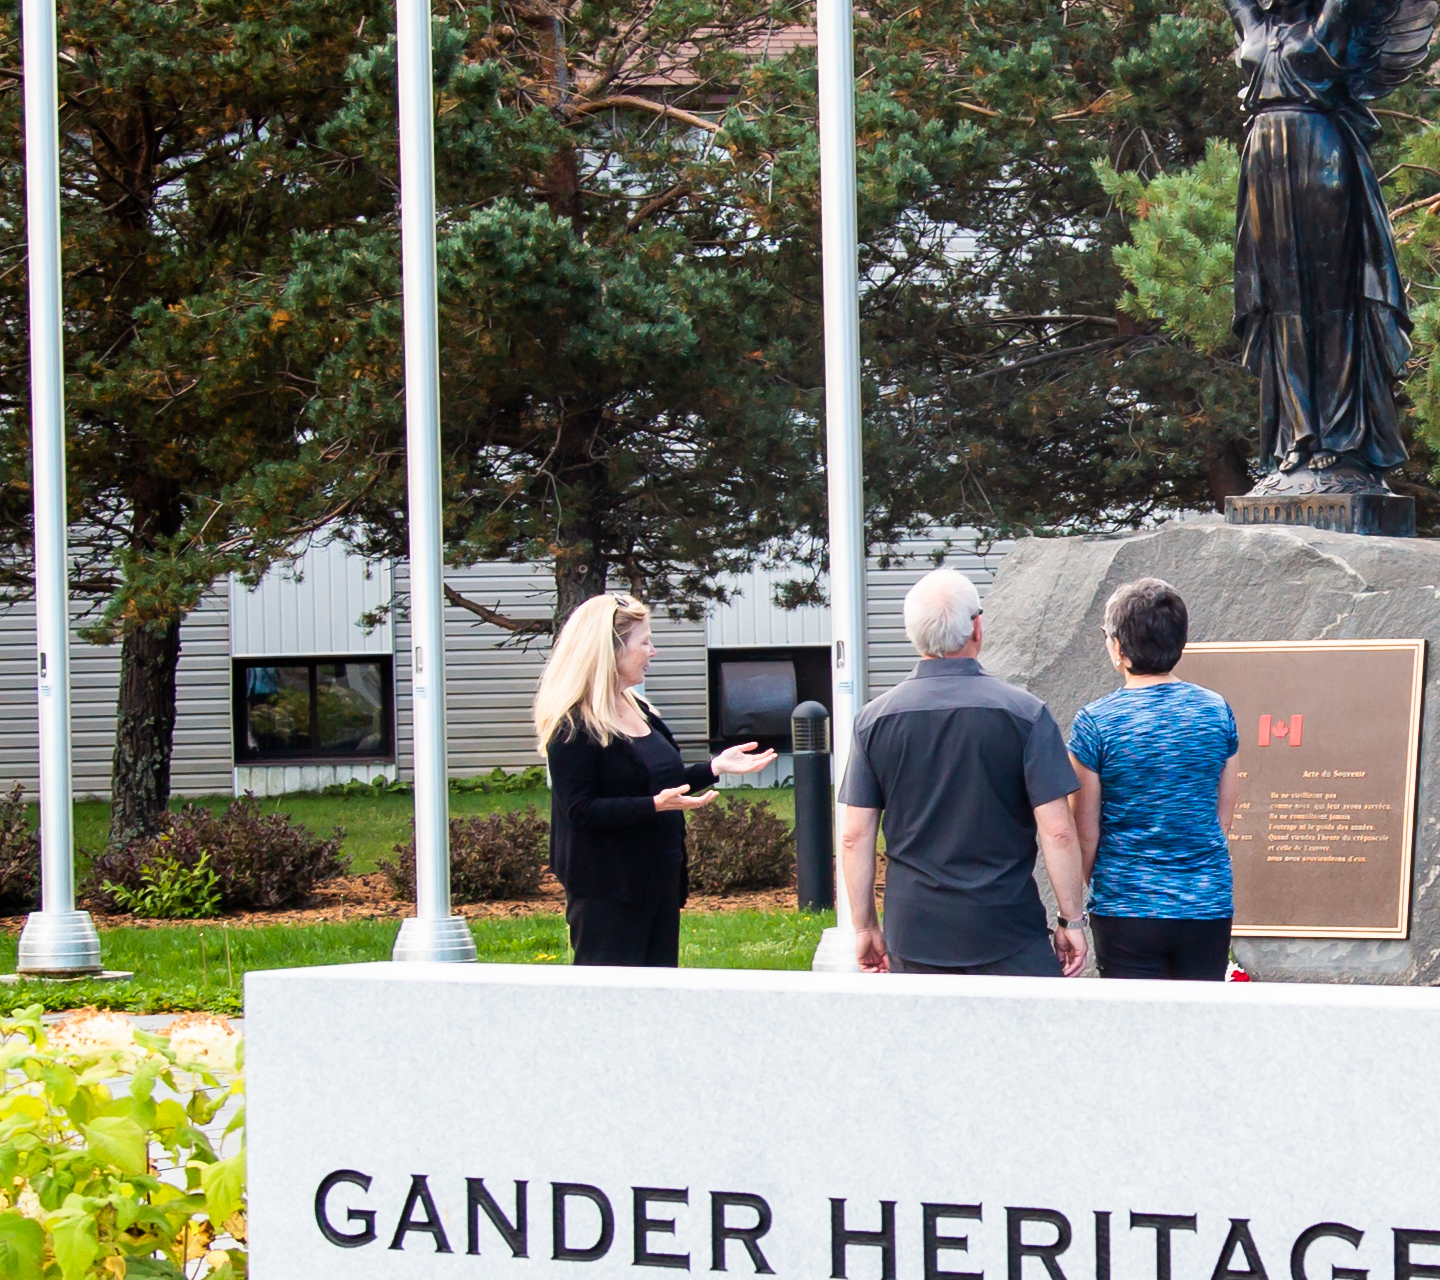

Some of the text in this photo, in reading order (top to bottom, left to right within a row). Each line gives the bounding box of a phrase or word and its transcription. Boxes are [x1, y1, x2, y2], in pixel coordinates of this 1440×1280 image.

[1302, 770, 1366, 778] Acte du Souvenir
[314, 1169, 776, 1276] GANDER
